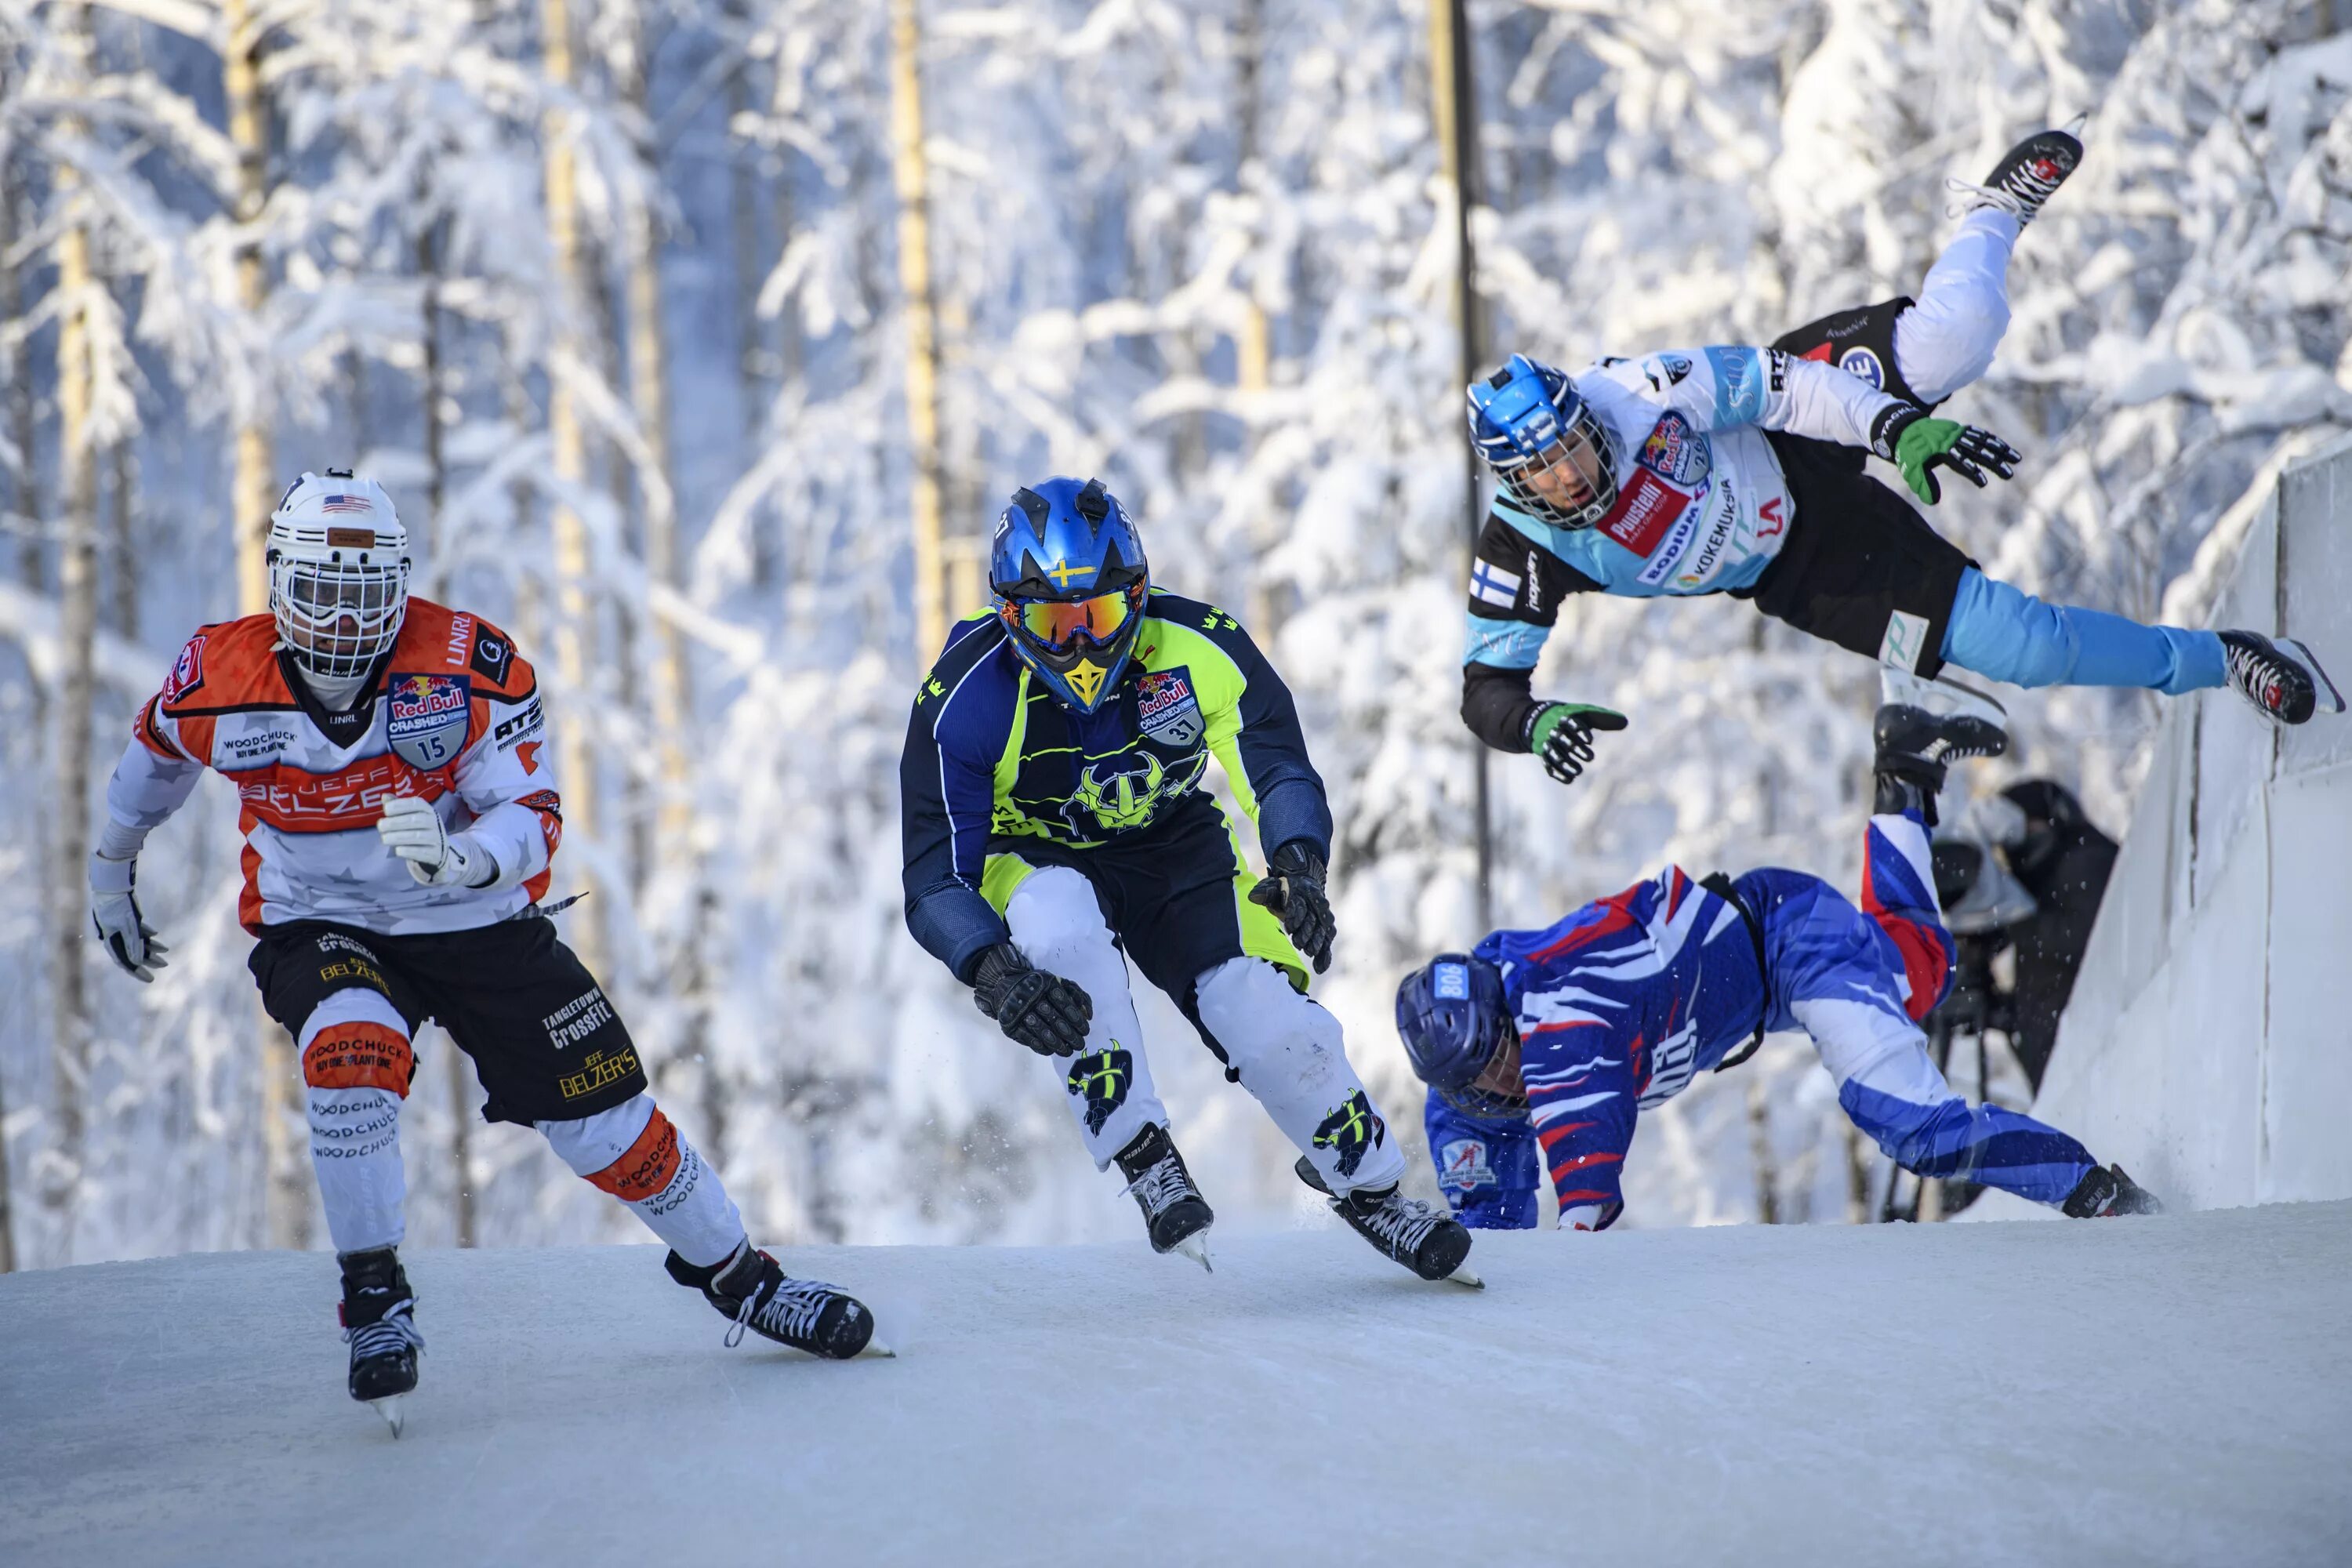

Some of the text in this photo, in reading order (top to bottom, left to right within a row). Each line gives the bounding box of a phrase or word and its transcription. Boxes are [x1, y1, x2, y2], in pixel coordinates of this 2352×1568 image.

[1693, 443, 1707, 468] 26
[1610, 481, 1662, 540] Puustelli
[1694, 478, 1736, 575] KOKEMUKSIA
[446, 615, 470, 666] UNRL
[393, 700, 427, 720] Red
[430, 688, 465, 712] Bull
[1139, 694, 1162, 718] Red
[1160, 679, 1191, 710] Bull
[330, 713, 358, 724] UNRL
[390, 713, 448, 733] CRASHED
[1140, 706, 1181, 729] CRASHED
[1168, 718, 1196, 741] 37
[224, 731, 296, 750] WOODCHUCK
[418, 734, 446, 761] 15
[298, 766, 390, 795] JEFF
[542, 986, 601, 1030] TANGLETOWN
[310, 1040, 402, 1062] WOODCHUCK
[584, 1050, 603, 1069] JEFF
[560, 1048, 637, 1098] BELZER'S
[1123, 1131, 1155, 1160] BAUER
